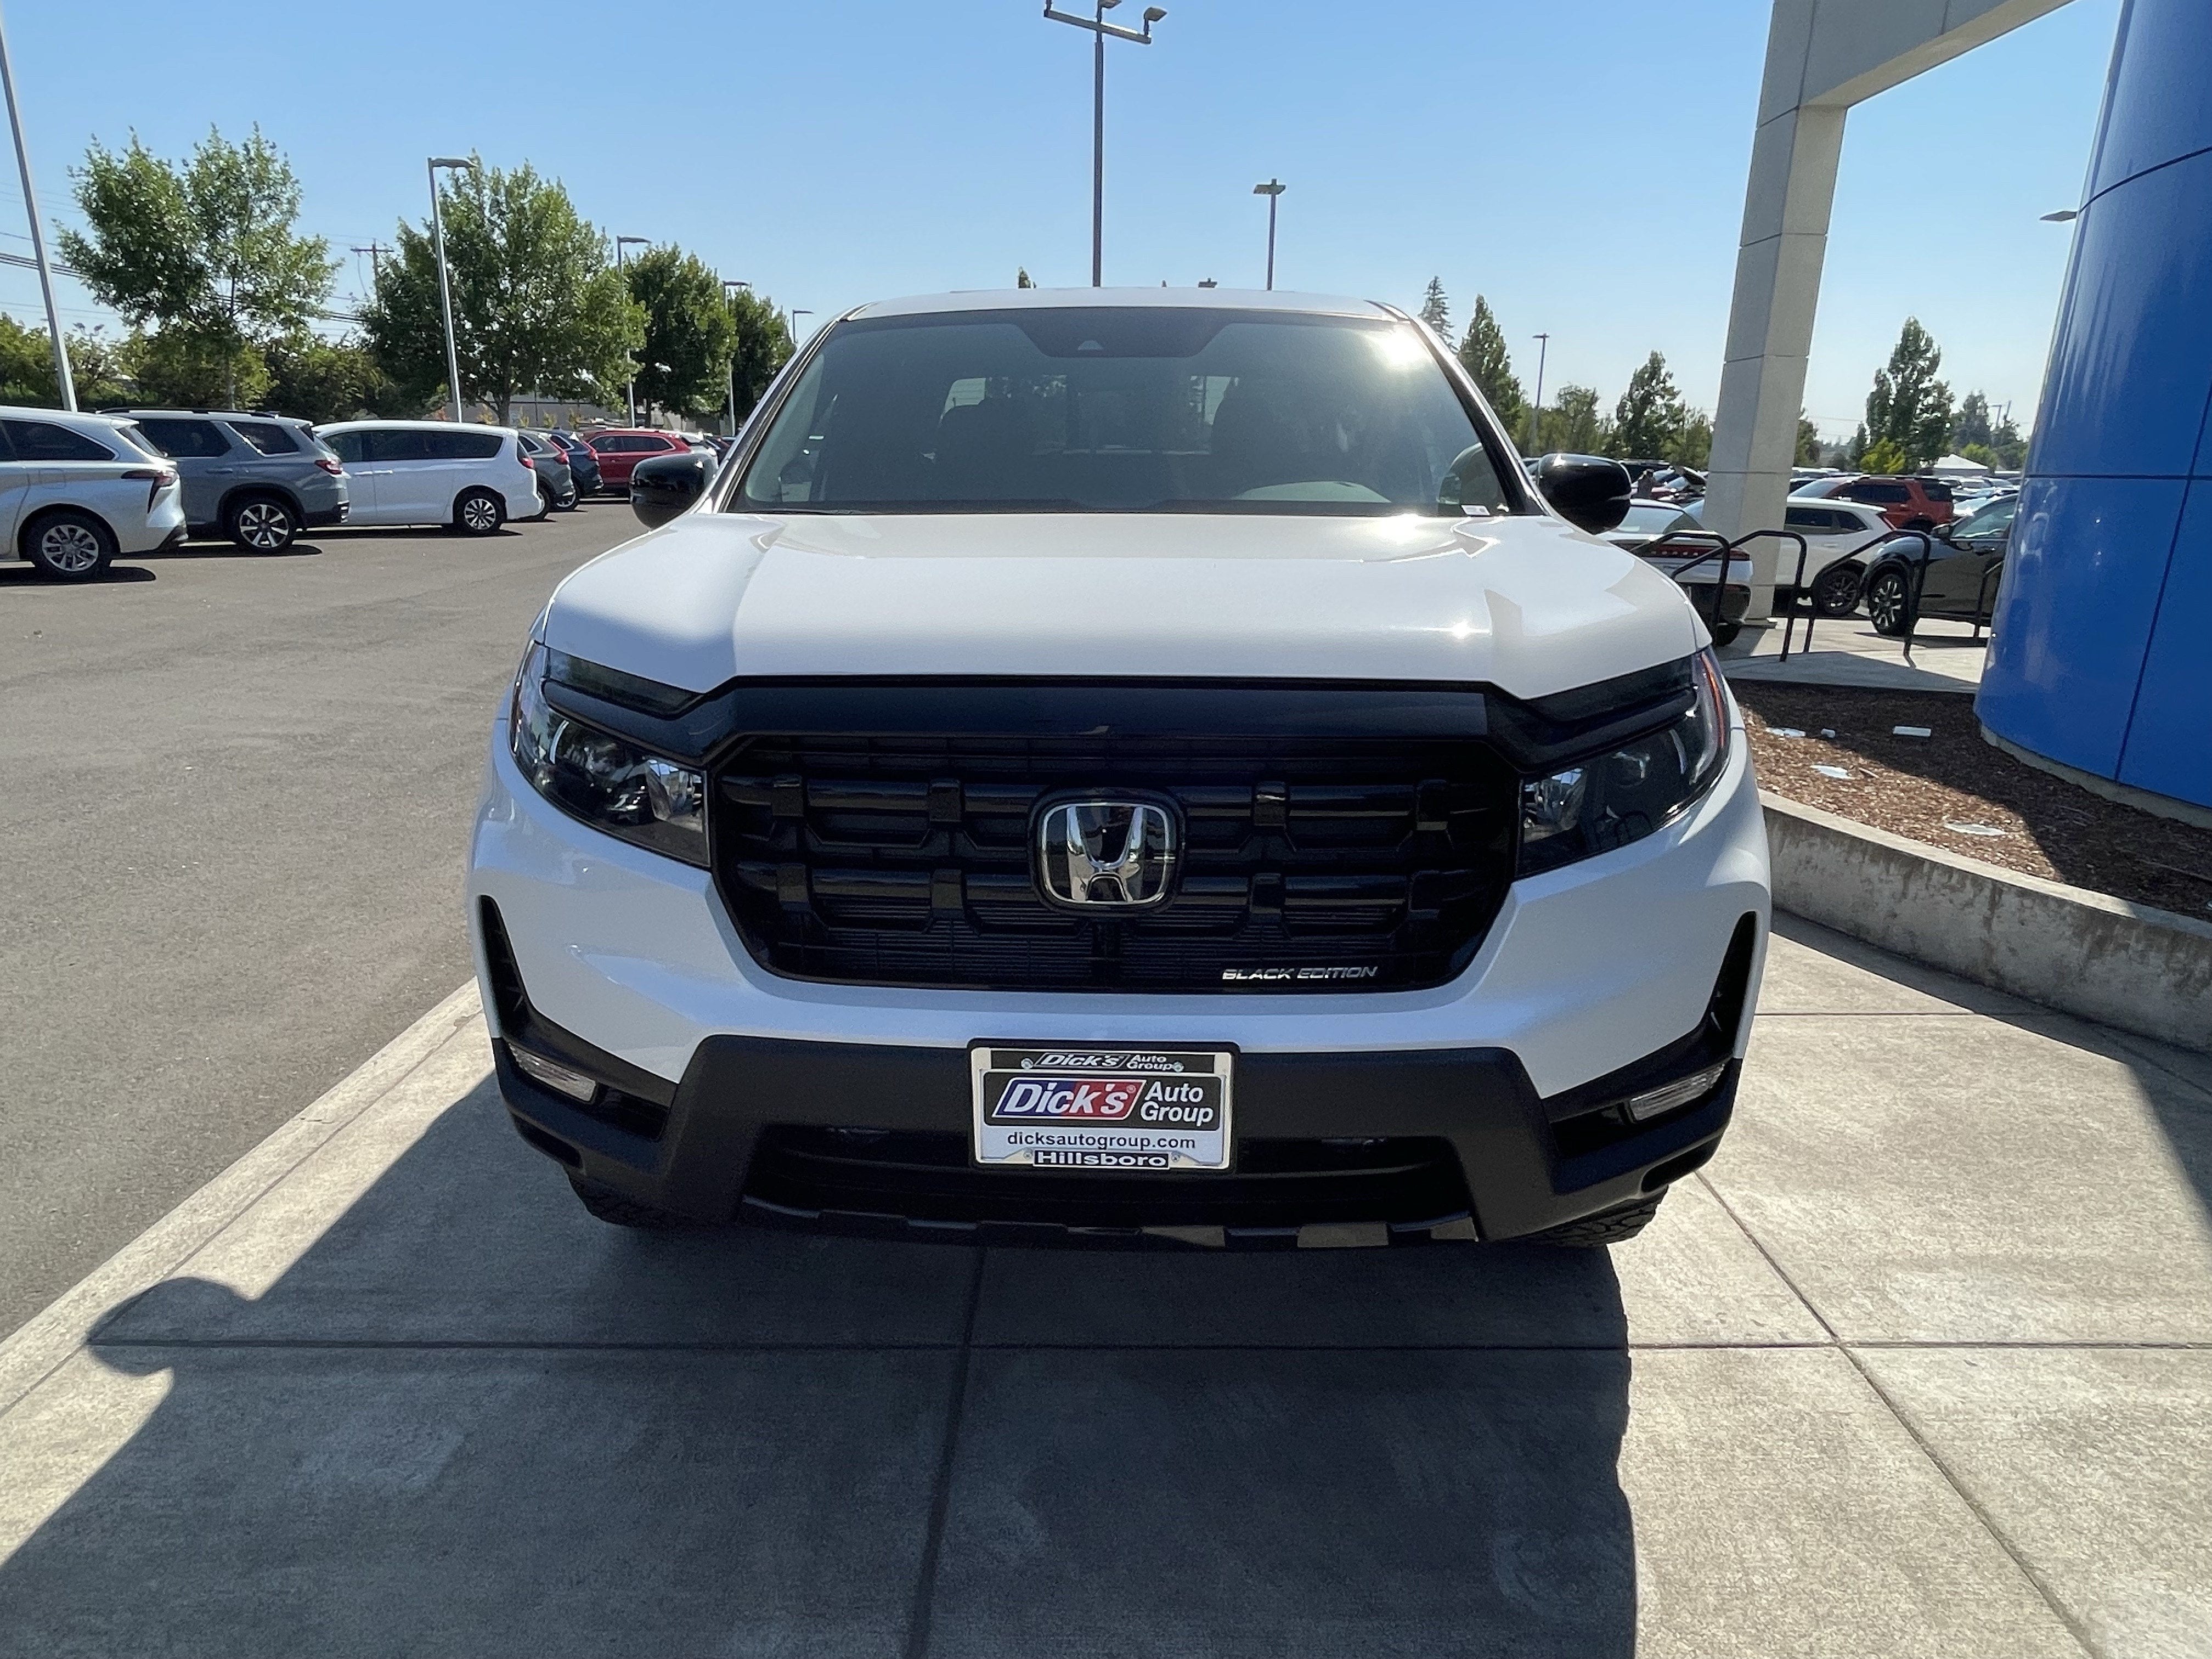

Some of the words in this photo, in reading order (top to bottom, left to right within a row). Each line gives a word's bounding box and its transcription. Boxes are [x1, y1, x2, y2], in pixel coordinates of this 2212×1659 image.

[1222, 968, 1295, 980] BLACK
[1297, 966, 1378, 979] EDITION
[1126, 1061, 1173, 1071] Group
[1132, 1054, 1167, 1063] Auto
[1144, 1081, 1204, 1103] Auto
[1140, 1101, 1214, 1126] Group
[1007, 1132, 1196, 1150] dicksautogroup.com
[1037, 1151, 1166, 1166] Hillsboro
